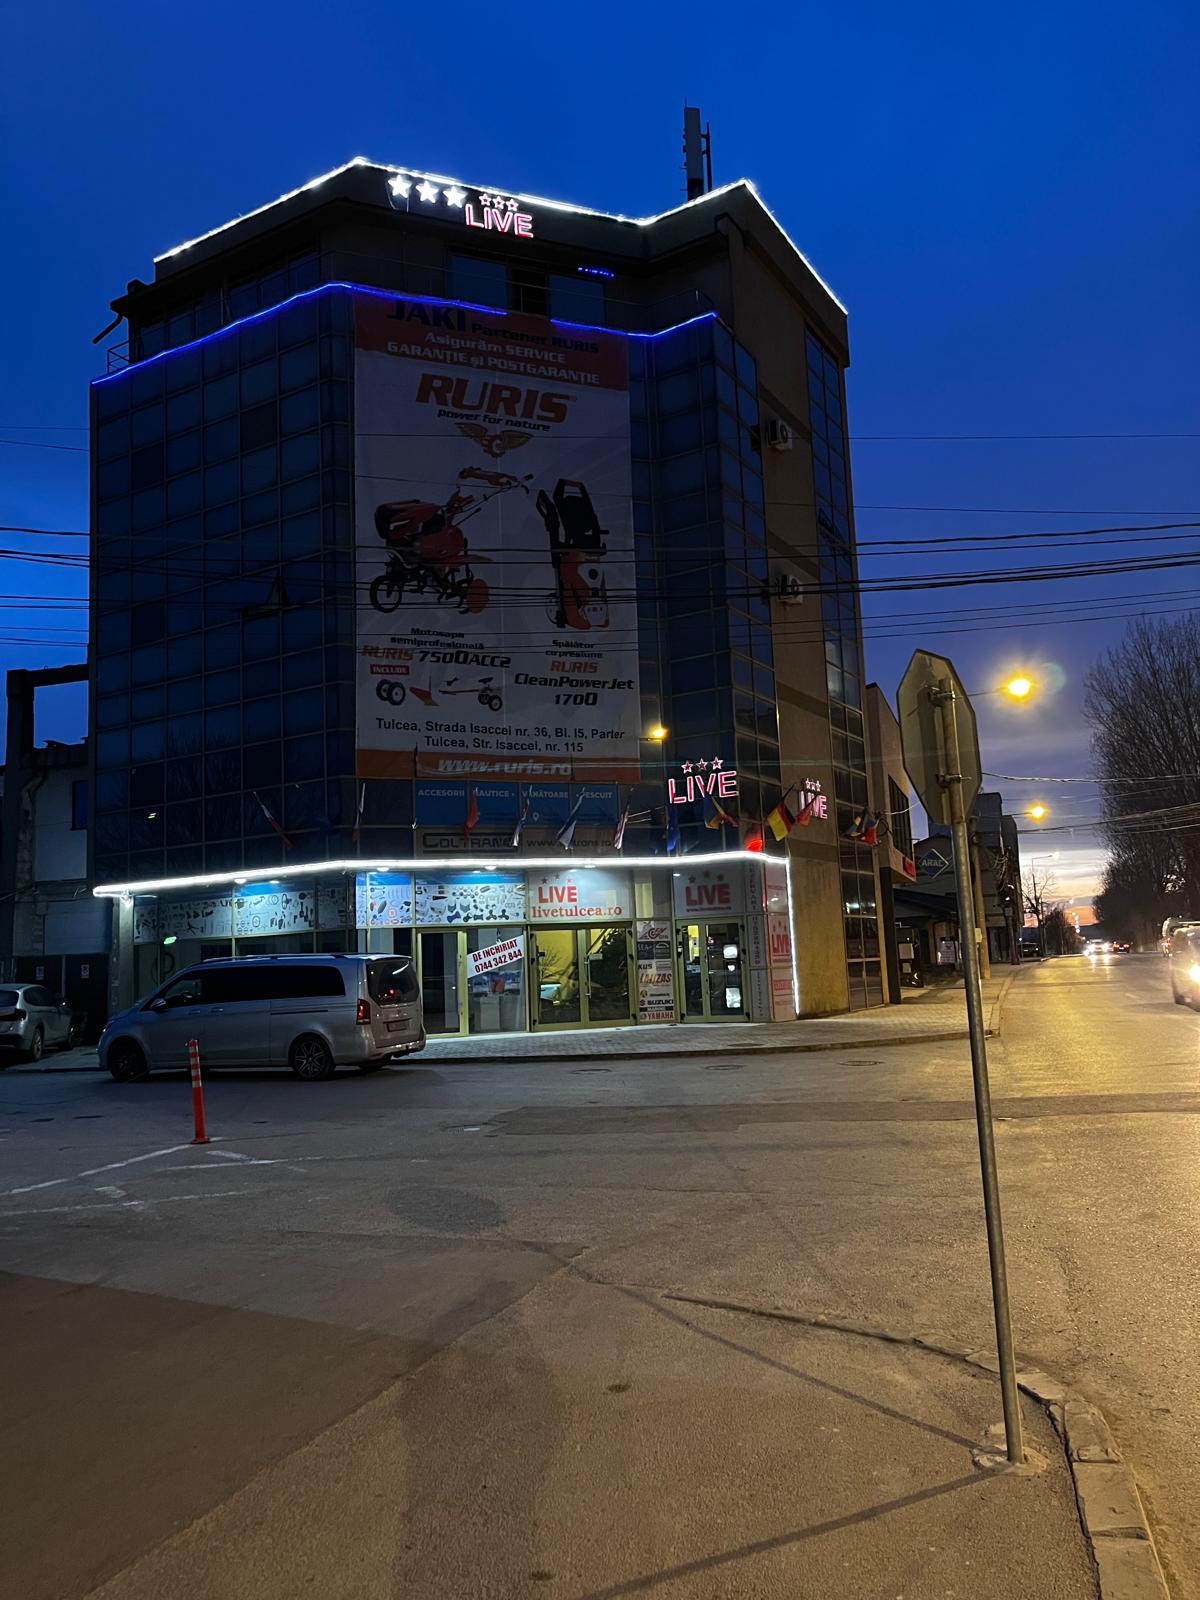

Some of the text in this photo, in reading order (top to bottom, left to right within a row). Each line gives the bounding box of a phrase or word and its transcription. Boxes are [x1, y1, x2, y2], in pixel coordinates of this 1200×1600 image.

[465, 203, 534, 238] LIVE
[387, 298, 599, 353] JAKI Partener RURIS
[505, 344, 566, 363] SERVICE
[415, 373, 571, 424] RURIS
[437, 409, 551, 432] power for nature
[361, 644, 414, 661] RURIS
[551, 660, 598, 673] RURIS
[514, 673, 634, 690] CleanPowerJet
[554, 692, 598, 706] 1700
[376, 718, 421, 732] Tulcea,
[425, 721, 466, 733] Strada
[470, 723, 512, 736] Isaccei
[515, 728, 530, 737] nr.
[534, 727, 551, 738] 36,
[555, 728, 570, 738] Bl.
[591, 729, 624, 739] Parter
[424, 736, 583, 752] Tulcea, Str. Isaccei, nr. 115
[667, 771, 739, 804] LIVE
[921, 859, 943, 867] ARAL
[537, 886, 577, 904] LIVE
[685, 884, 730, 907] LIVE
[532, 906, 622, 918] livetulcea.ro
[472, 940, 518, 962] DE INCHIRIAT
[474, 948, 523, 974] 0744 342 844
[647, 1012, 673, 1020] YAMAHA
